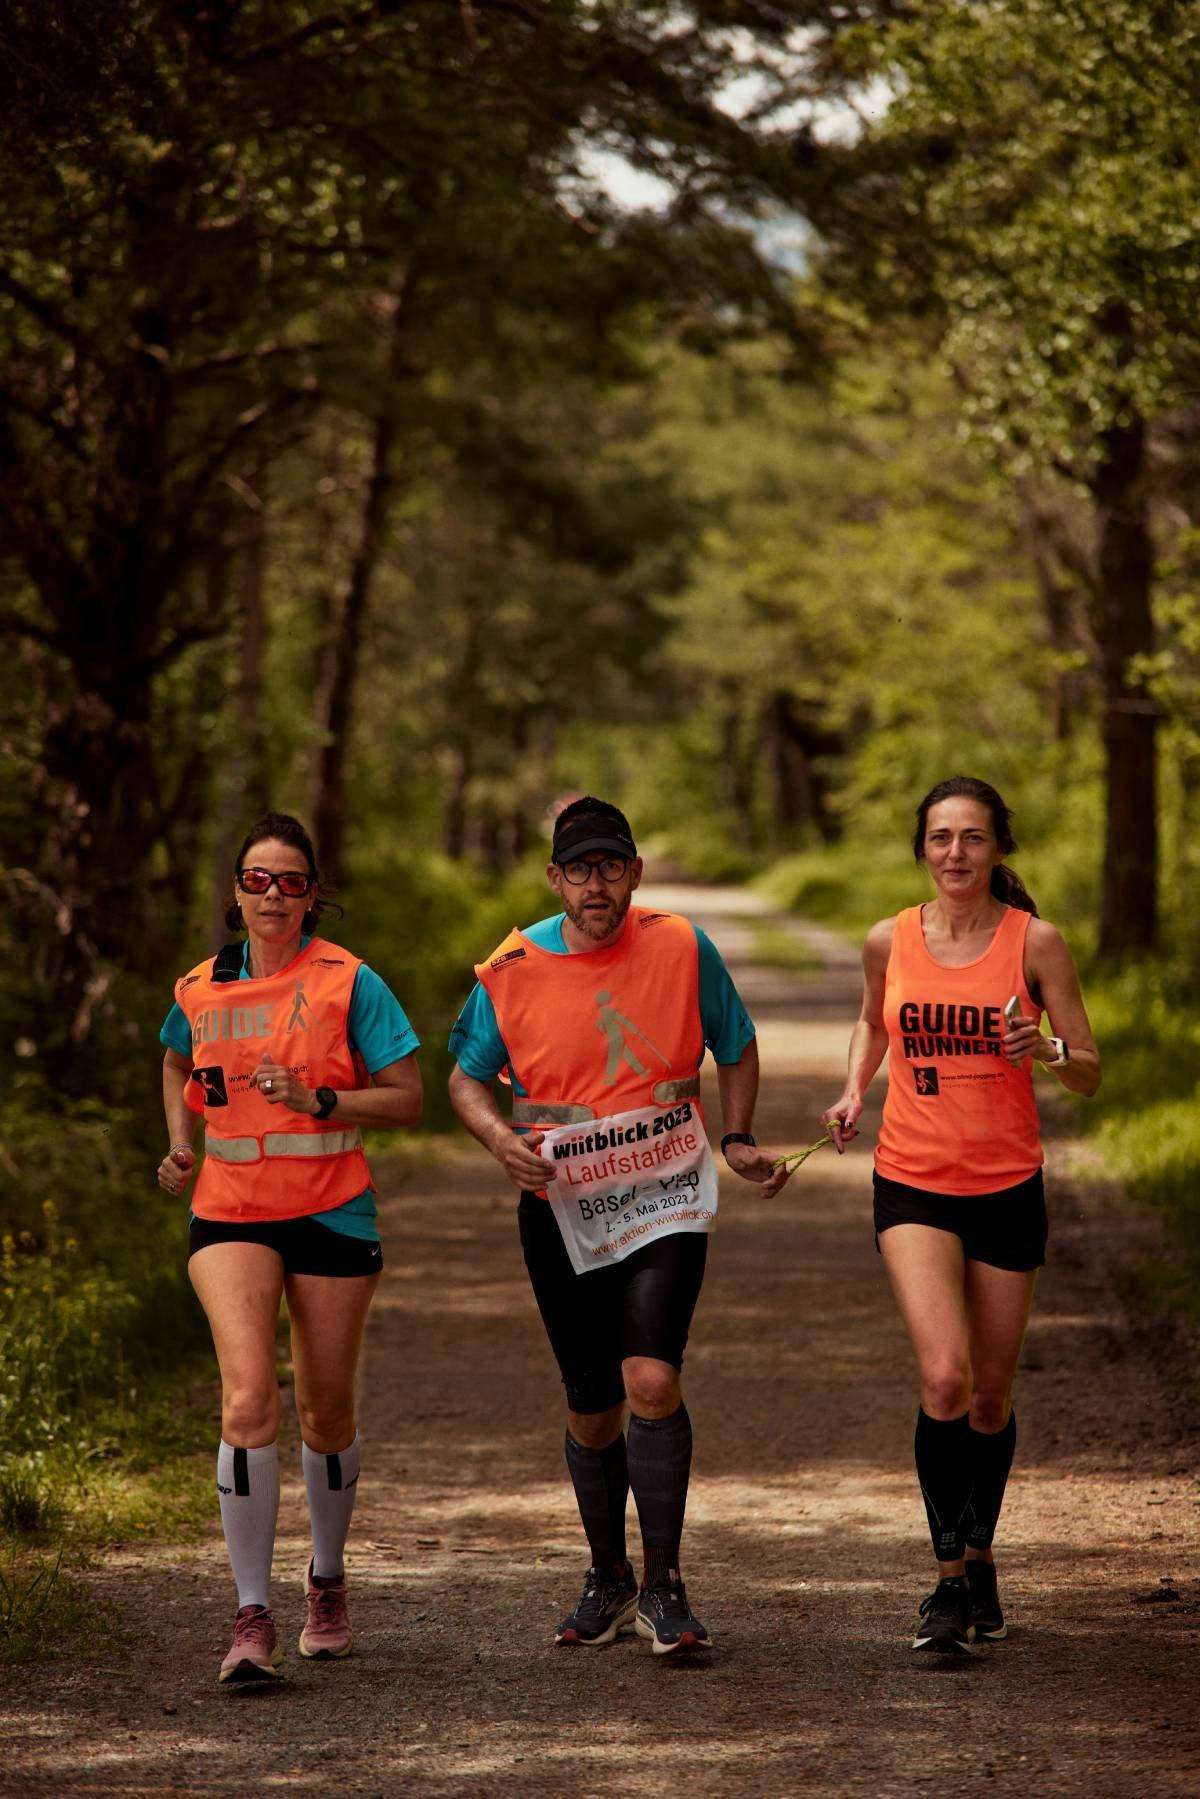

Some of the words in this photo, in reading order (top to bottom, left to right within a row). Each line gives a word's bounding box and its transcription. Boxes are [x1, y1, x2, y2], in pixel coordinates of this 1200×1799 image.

[192, 1004, 273, 1048] GUIDE
[899, 1002, 1001, 1038] GUIDE
[903, 1036, 1001, 1058] RUNNER
[552, 1121, 649, 1160] wiitblick
[653, 1102, 693, 1136] 2023
[566, 1133, 697, 1186] Laufstafette
[579, 1186, 636, 1221] Basel
[623, 1212, 634, 1223] 5.
[636, 1201, 659, 1217] Mai
[660, 1194, 689, 1210] 2023
[592, 1208, 714, 1257] www.aktion-wiitblick.ch
